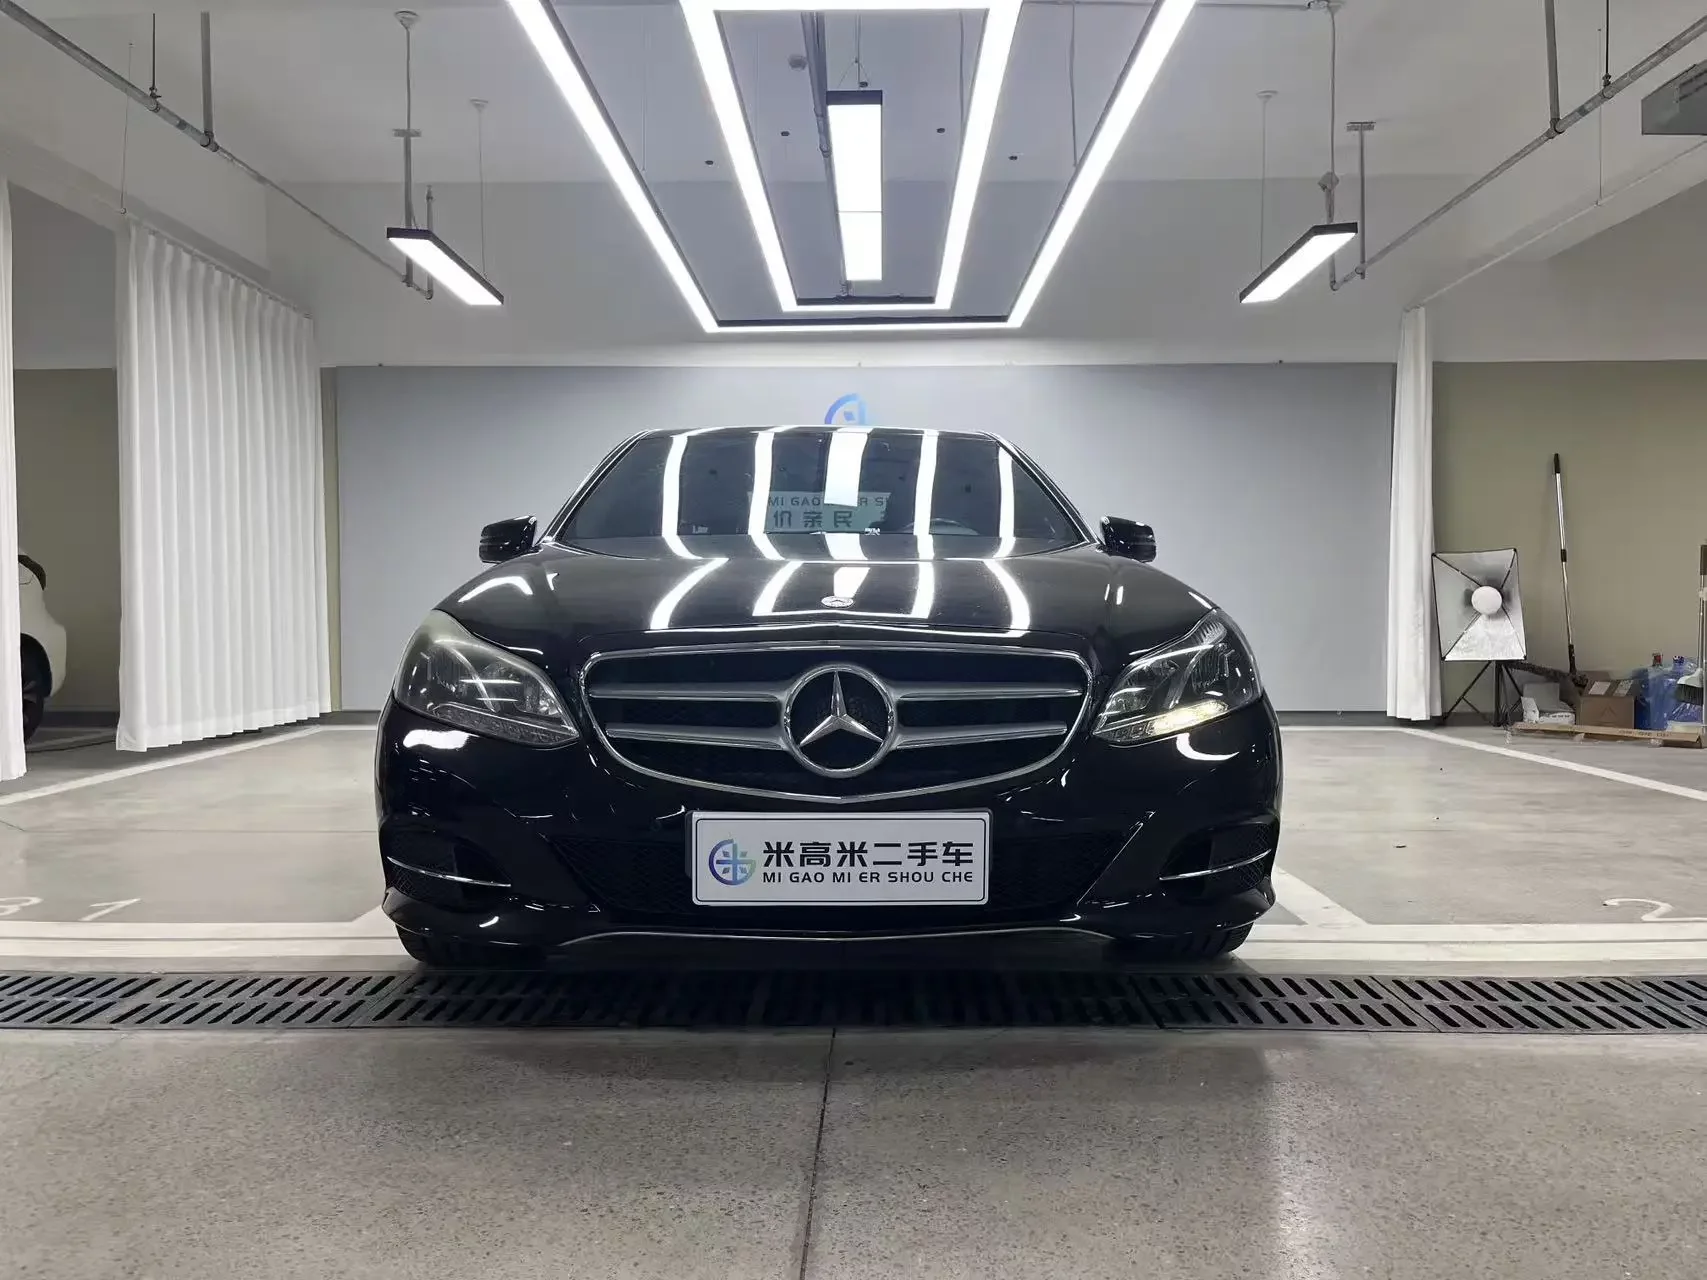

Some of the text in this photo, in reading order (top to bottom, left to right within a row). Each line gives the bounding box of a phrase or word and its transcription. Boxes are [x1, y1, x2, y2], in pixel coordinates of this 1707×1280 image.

[791, 497, 821, 506] GAO
[763, 841, 973, 867] 米高米二手车
[763, 872, 973, 882] MI GAO MI ER SHOU CHE
